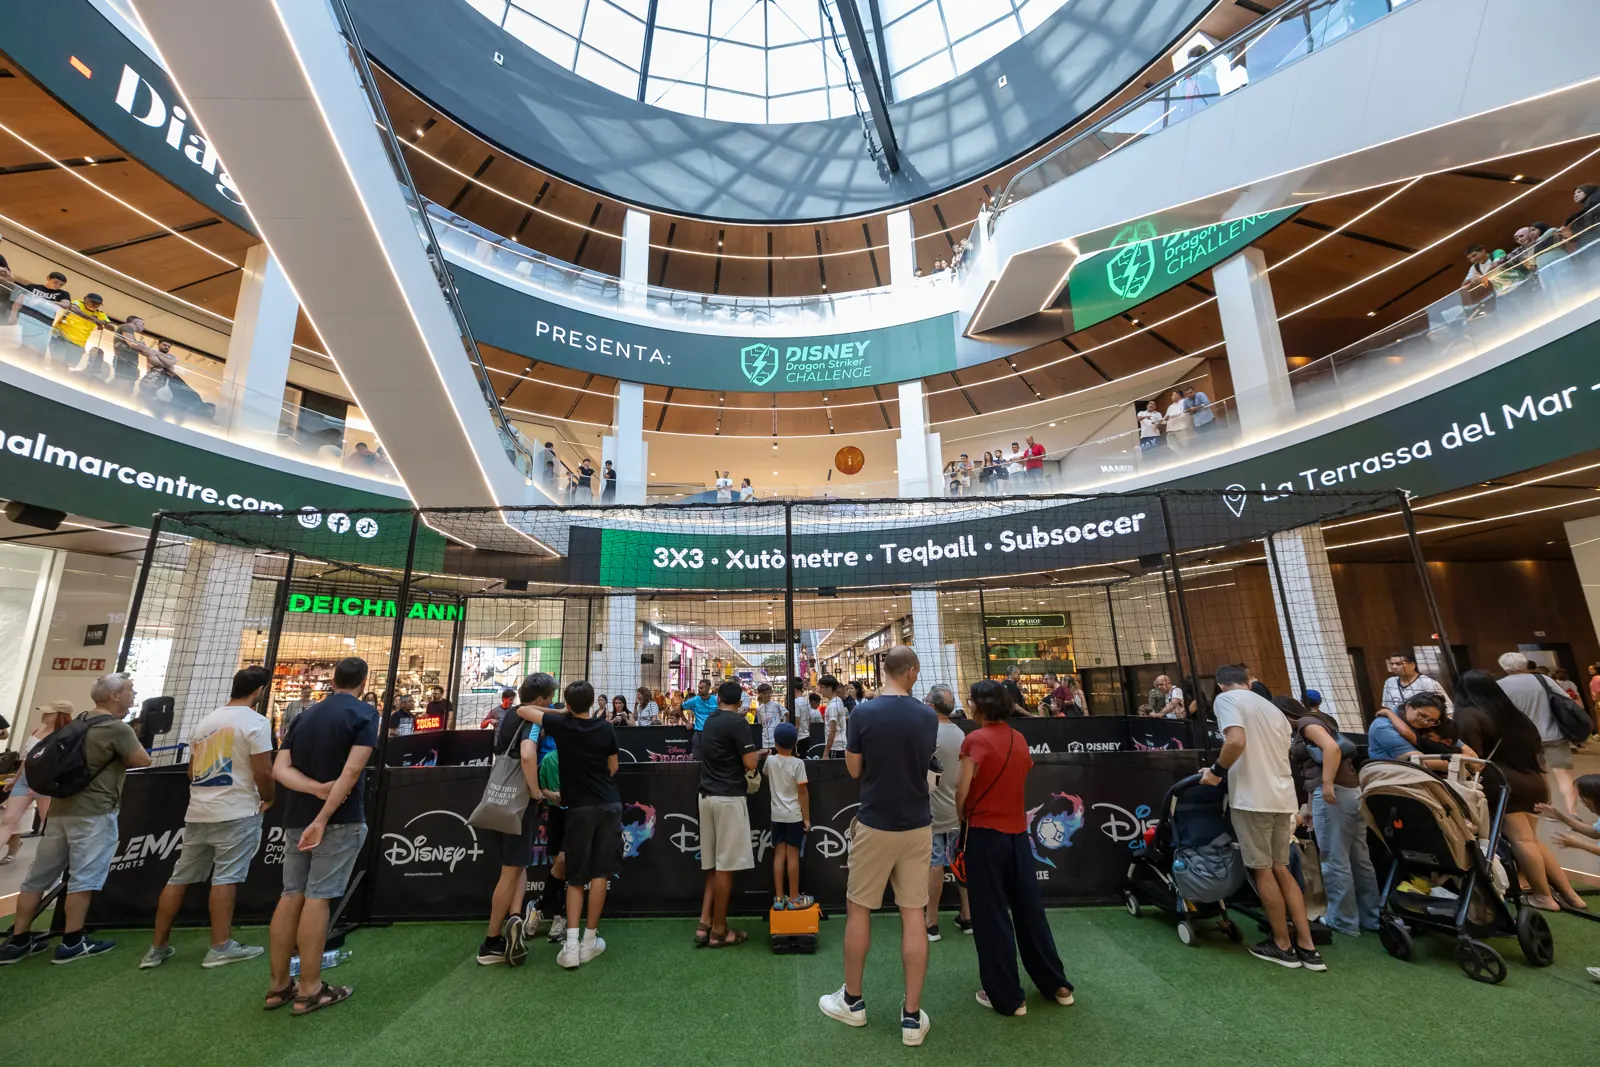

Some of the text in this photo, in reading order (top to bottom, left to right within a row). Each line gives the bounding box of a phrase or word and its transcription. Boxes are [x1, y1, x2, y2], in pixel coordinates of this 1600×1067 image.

[116, 64, 245, 206] Diag
[536, 320, 671, 365] PRESENTA:
[786, 340, 871, 361] DISNEY
[786, 358, 864, 372] Dragon Striker
[786, 366, 873, 383] CHALLENGE
[1260, 385, 1577, 502] La Terrassa del Mar
[0, 429, 284, 518] almarcentre.com
[653, 547, 704, 568] 3X3
[879, 535, 977, 566] Teqball
[999, 513, 1146, 552] Subsoccer
[1086, 742, 1121, 750] DISNEY
[490, 783, 518, 793] TOGETHER
[495, 791, 516, 799] DREAM
[487, 797, 509, 805] BIGGER
[109, 859, 144, 872] PORTS
